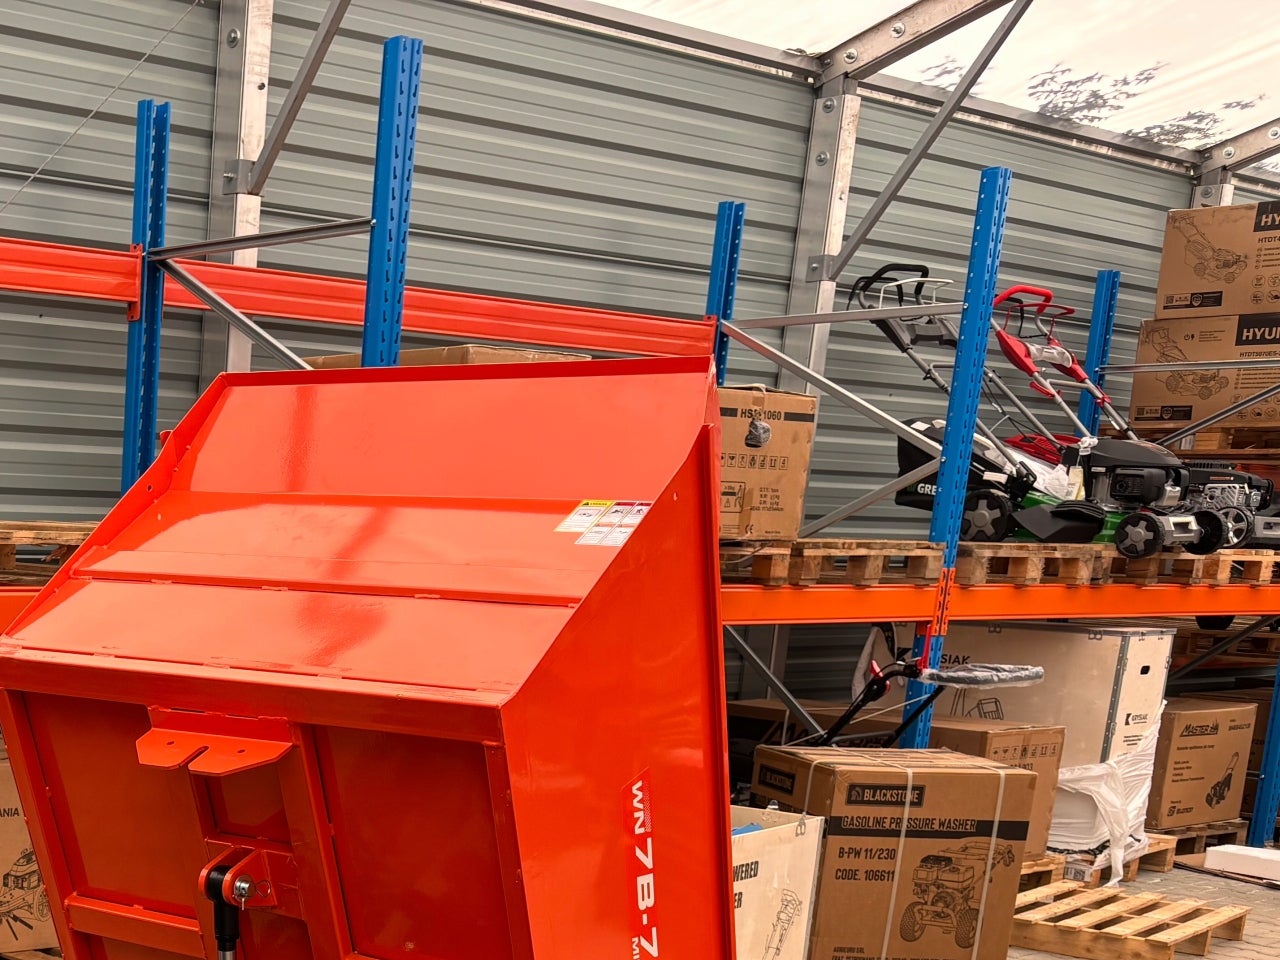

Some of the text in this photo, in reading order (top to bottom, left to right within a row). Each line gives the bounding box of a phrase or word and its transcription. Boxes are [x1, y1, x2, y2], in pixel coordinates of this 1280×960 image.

[842, 816, 977, 832] GASOLINE PRSSURE WASHER
[838, 847, 896, 860] B-PW 11/230
[835, 868, 861, 881] CODE.
